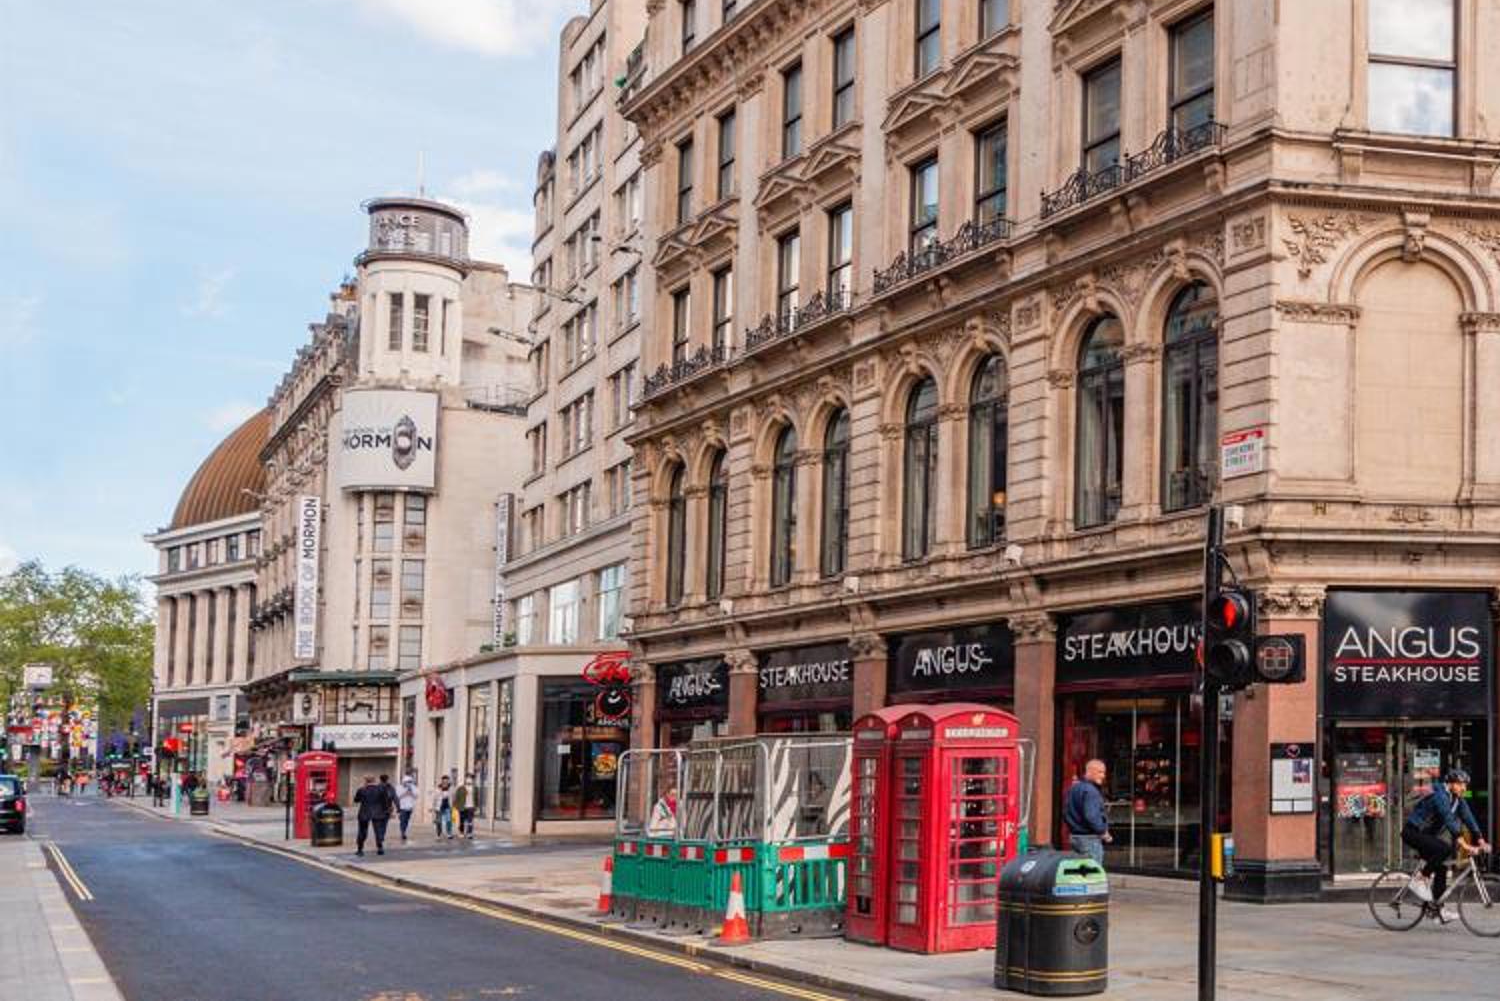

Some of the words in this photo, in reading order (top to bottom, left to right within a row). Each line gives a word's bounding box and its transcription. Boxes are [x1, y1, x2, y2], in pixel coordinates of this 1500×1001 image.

[303, 499, 317, 559] MORMON
[1334, 626, 1481, 658] ANGUS
[759, 660, 850, 689] STEAKHOUSE
[912, 644, 981, 677] ANGUS
[1334, 666, 1481, 683] STEAKHOUSE
[669, 673, 713, 698] ANGUS
